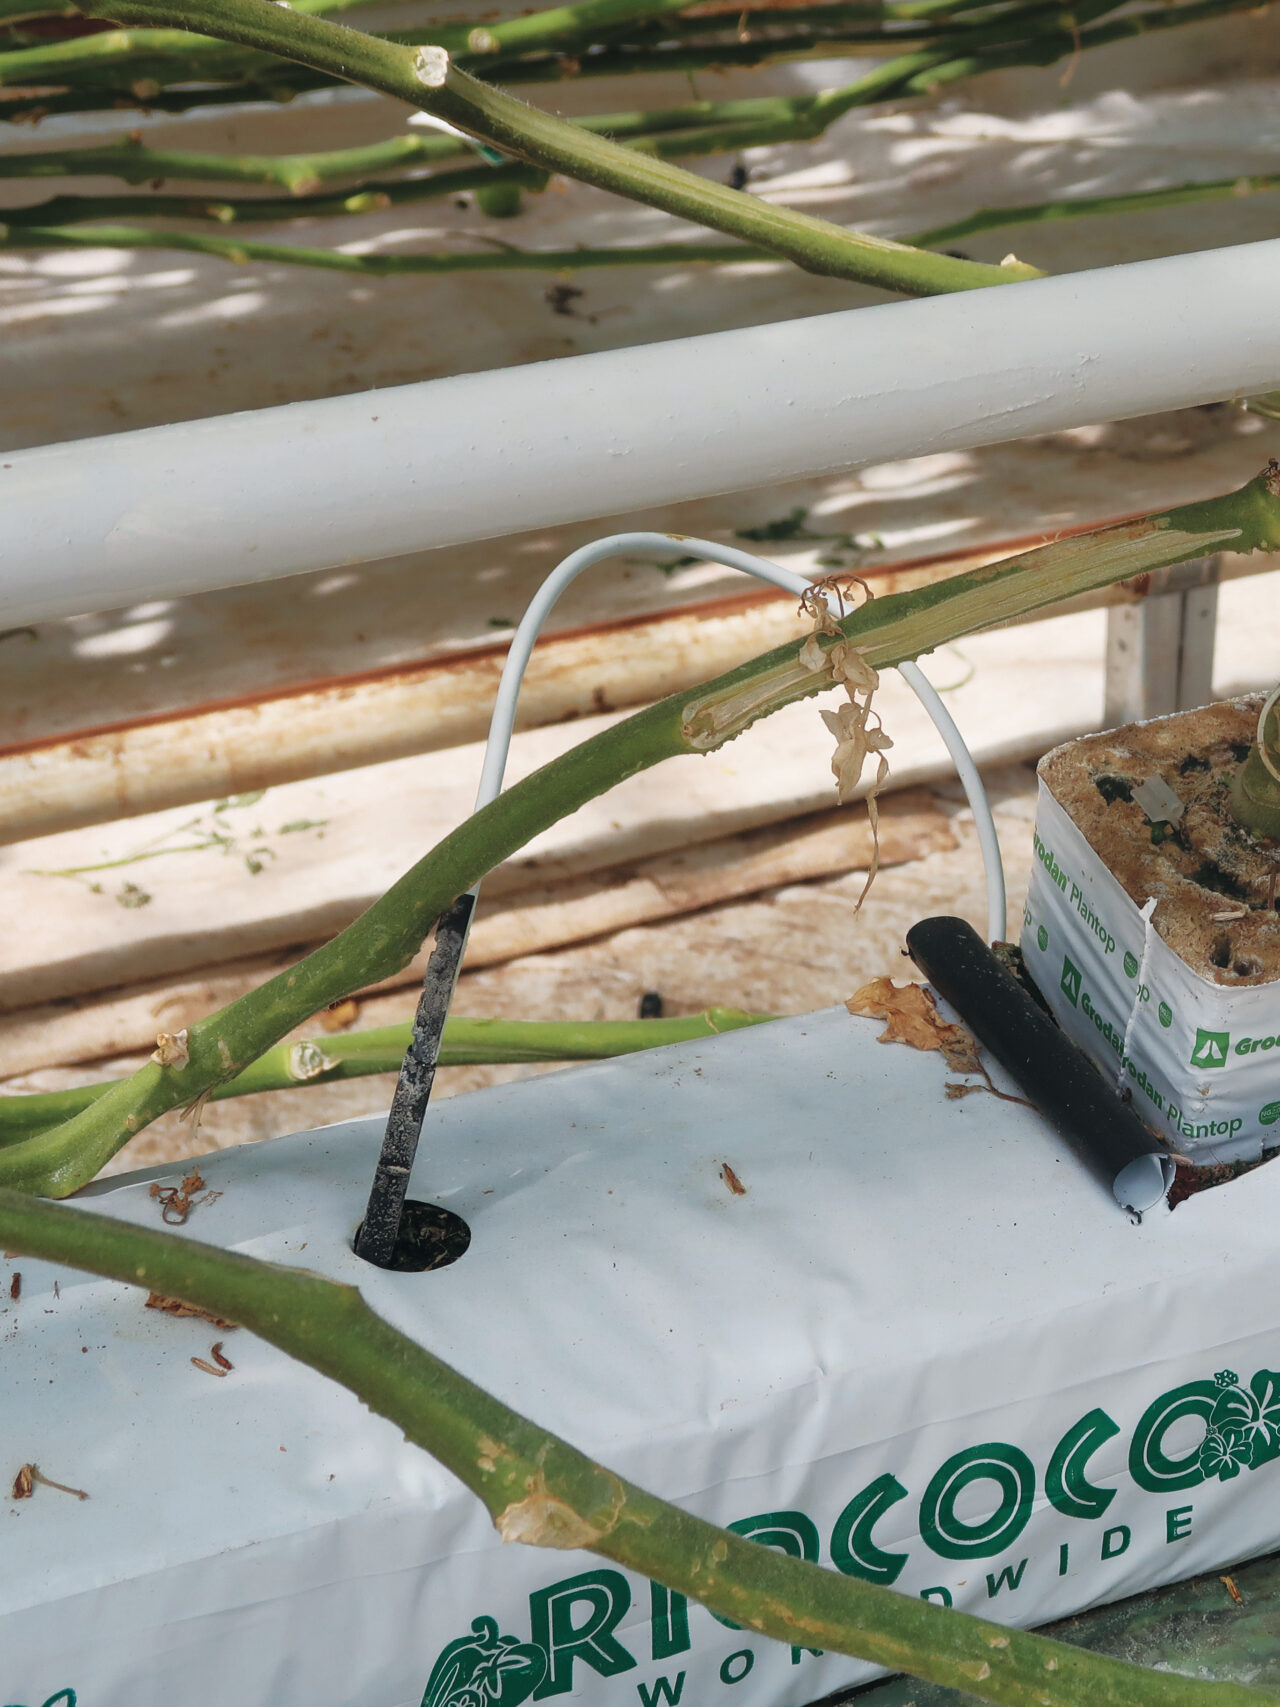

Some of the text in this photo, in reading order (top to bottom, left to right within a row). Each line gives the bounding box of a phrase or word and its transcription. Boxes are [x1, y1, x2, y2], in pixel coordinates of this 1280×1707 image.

[1034, 834, 1116, 954] rodan Plantop
[1121, 1055, 1243, 1139] rodan Plantop
